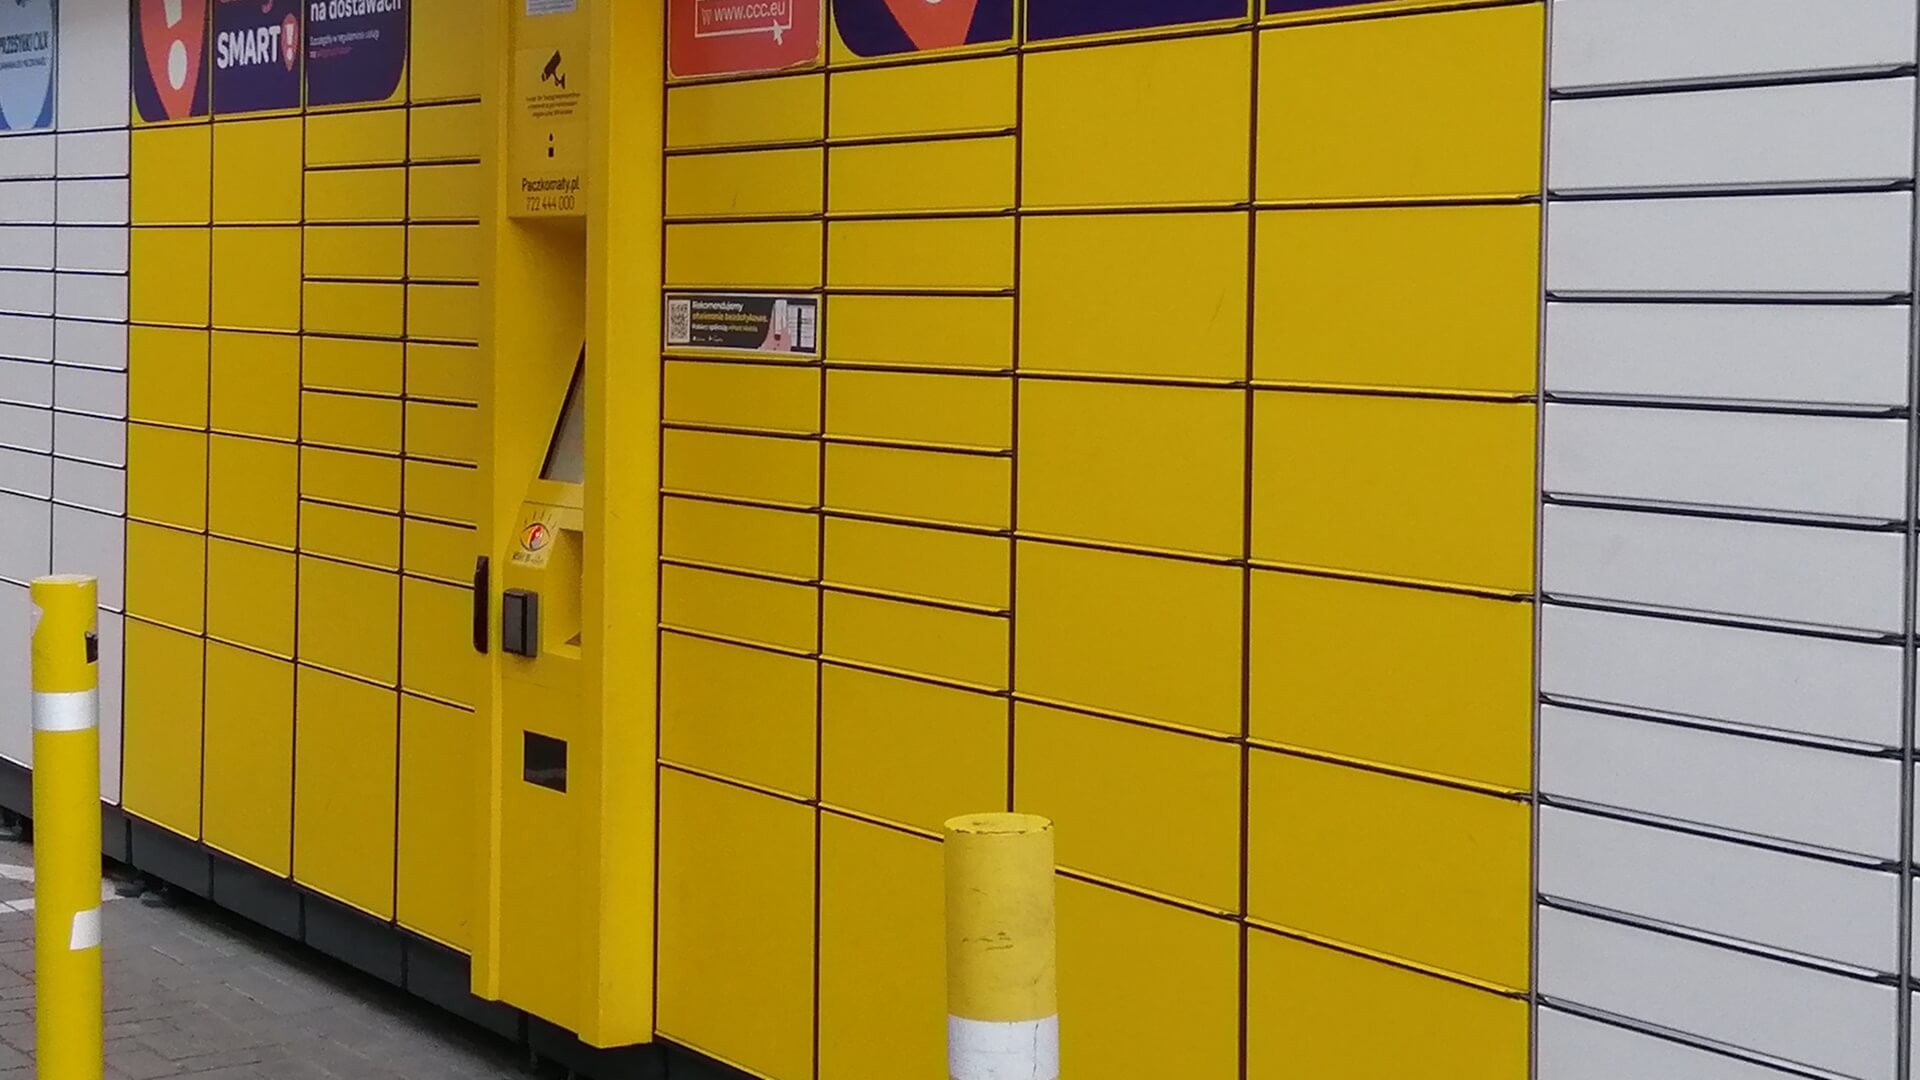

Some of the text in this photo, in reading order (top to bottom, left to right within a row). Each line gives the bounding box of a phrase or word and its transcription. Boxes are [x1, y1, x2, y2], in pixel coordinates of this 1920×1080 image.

[311, 2, 326, 21] na
[714, 1, 785, 22] www.ccc.eu
[521, 176, 580, 194] Paczkomaty.pl
[526, 194, 575, 211] 722 444 000
